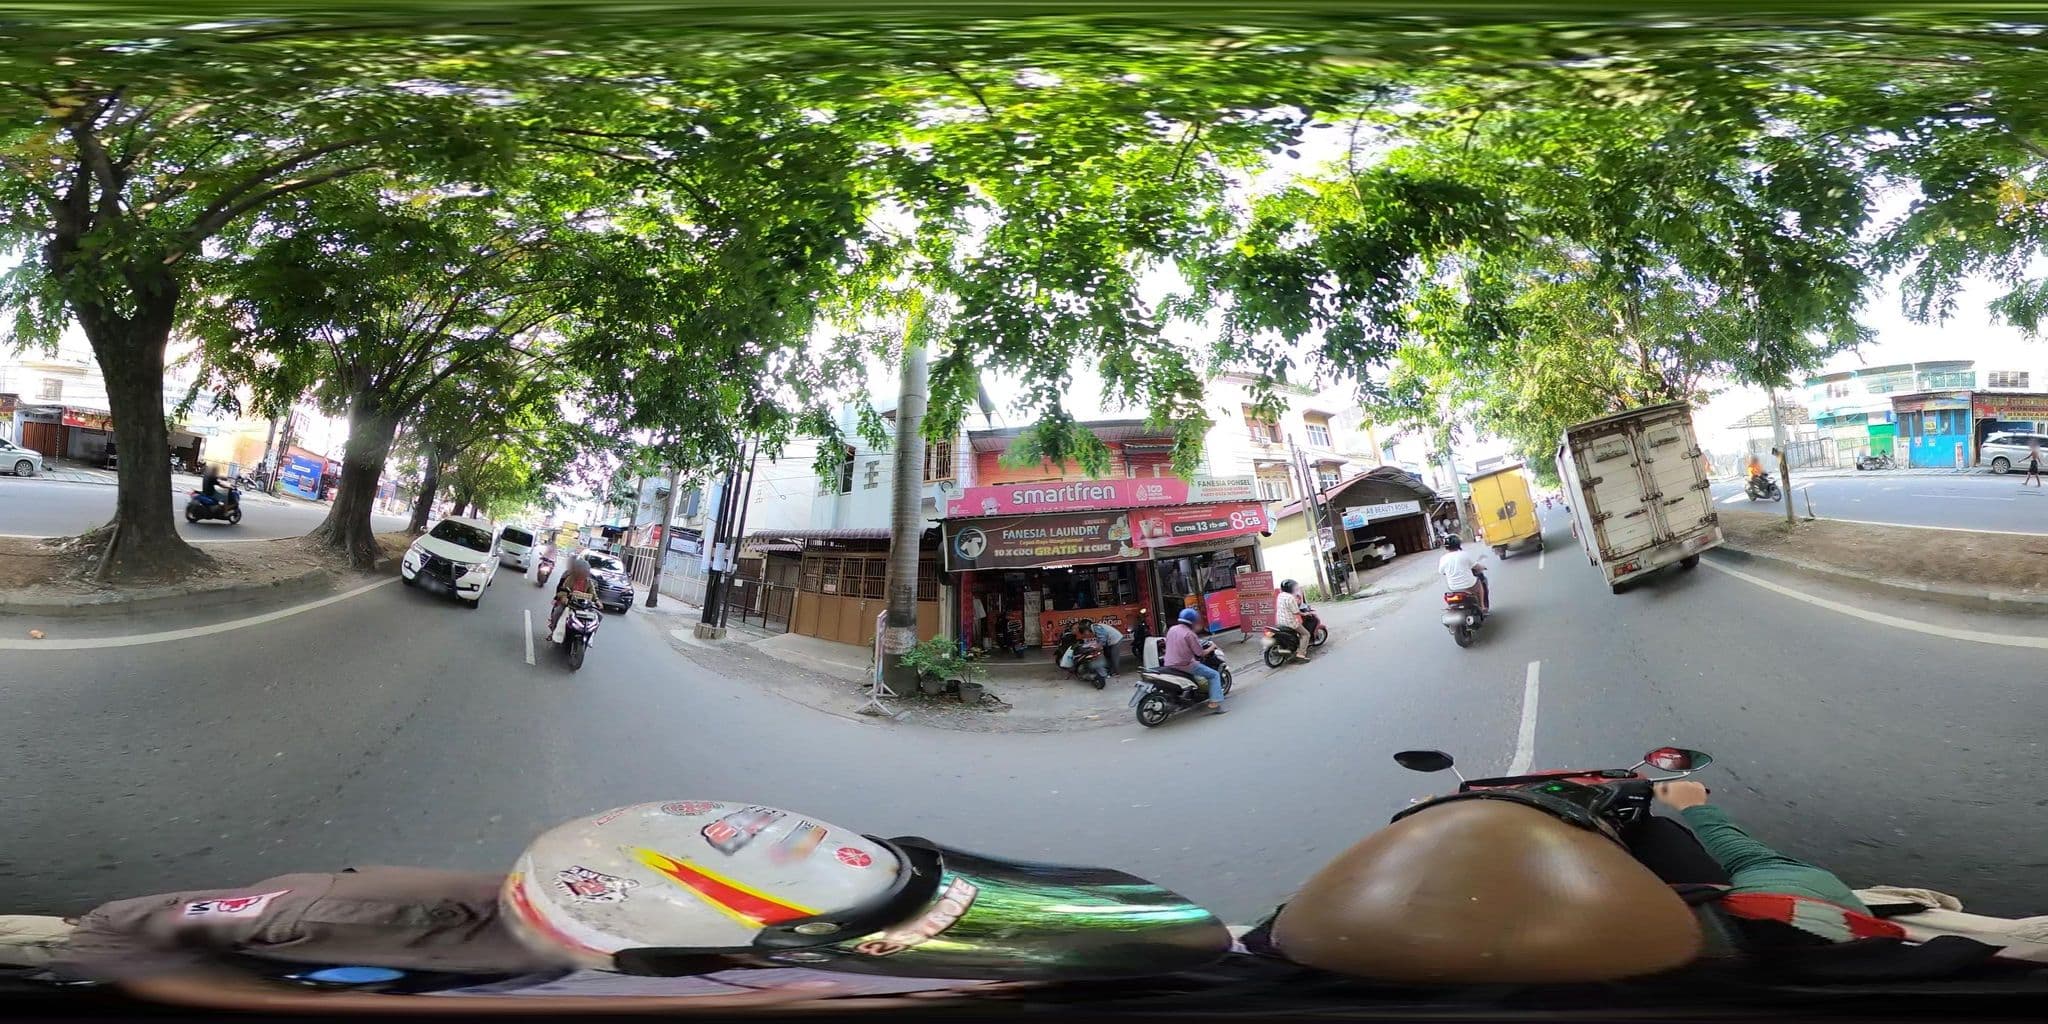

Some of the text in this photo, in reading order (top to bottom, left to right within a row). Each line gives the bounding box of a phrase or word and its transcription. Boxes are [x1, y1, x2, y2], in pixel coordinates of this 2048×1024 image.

[1012, 483, 1116, 505] smartfren
[1196, 521, 1208, 531] 13
[1230, 511, 1245, 530] 8
[1245, 516, 1261, 526] GB
[1002, 525, 1100, 539] FANESIA LAUNDRY
[1034, 544, 1078, 556] GRATIS
[1091, 543, 1112, 552] CUCI
